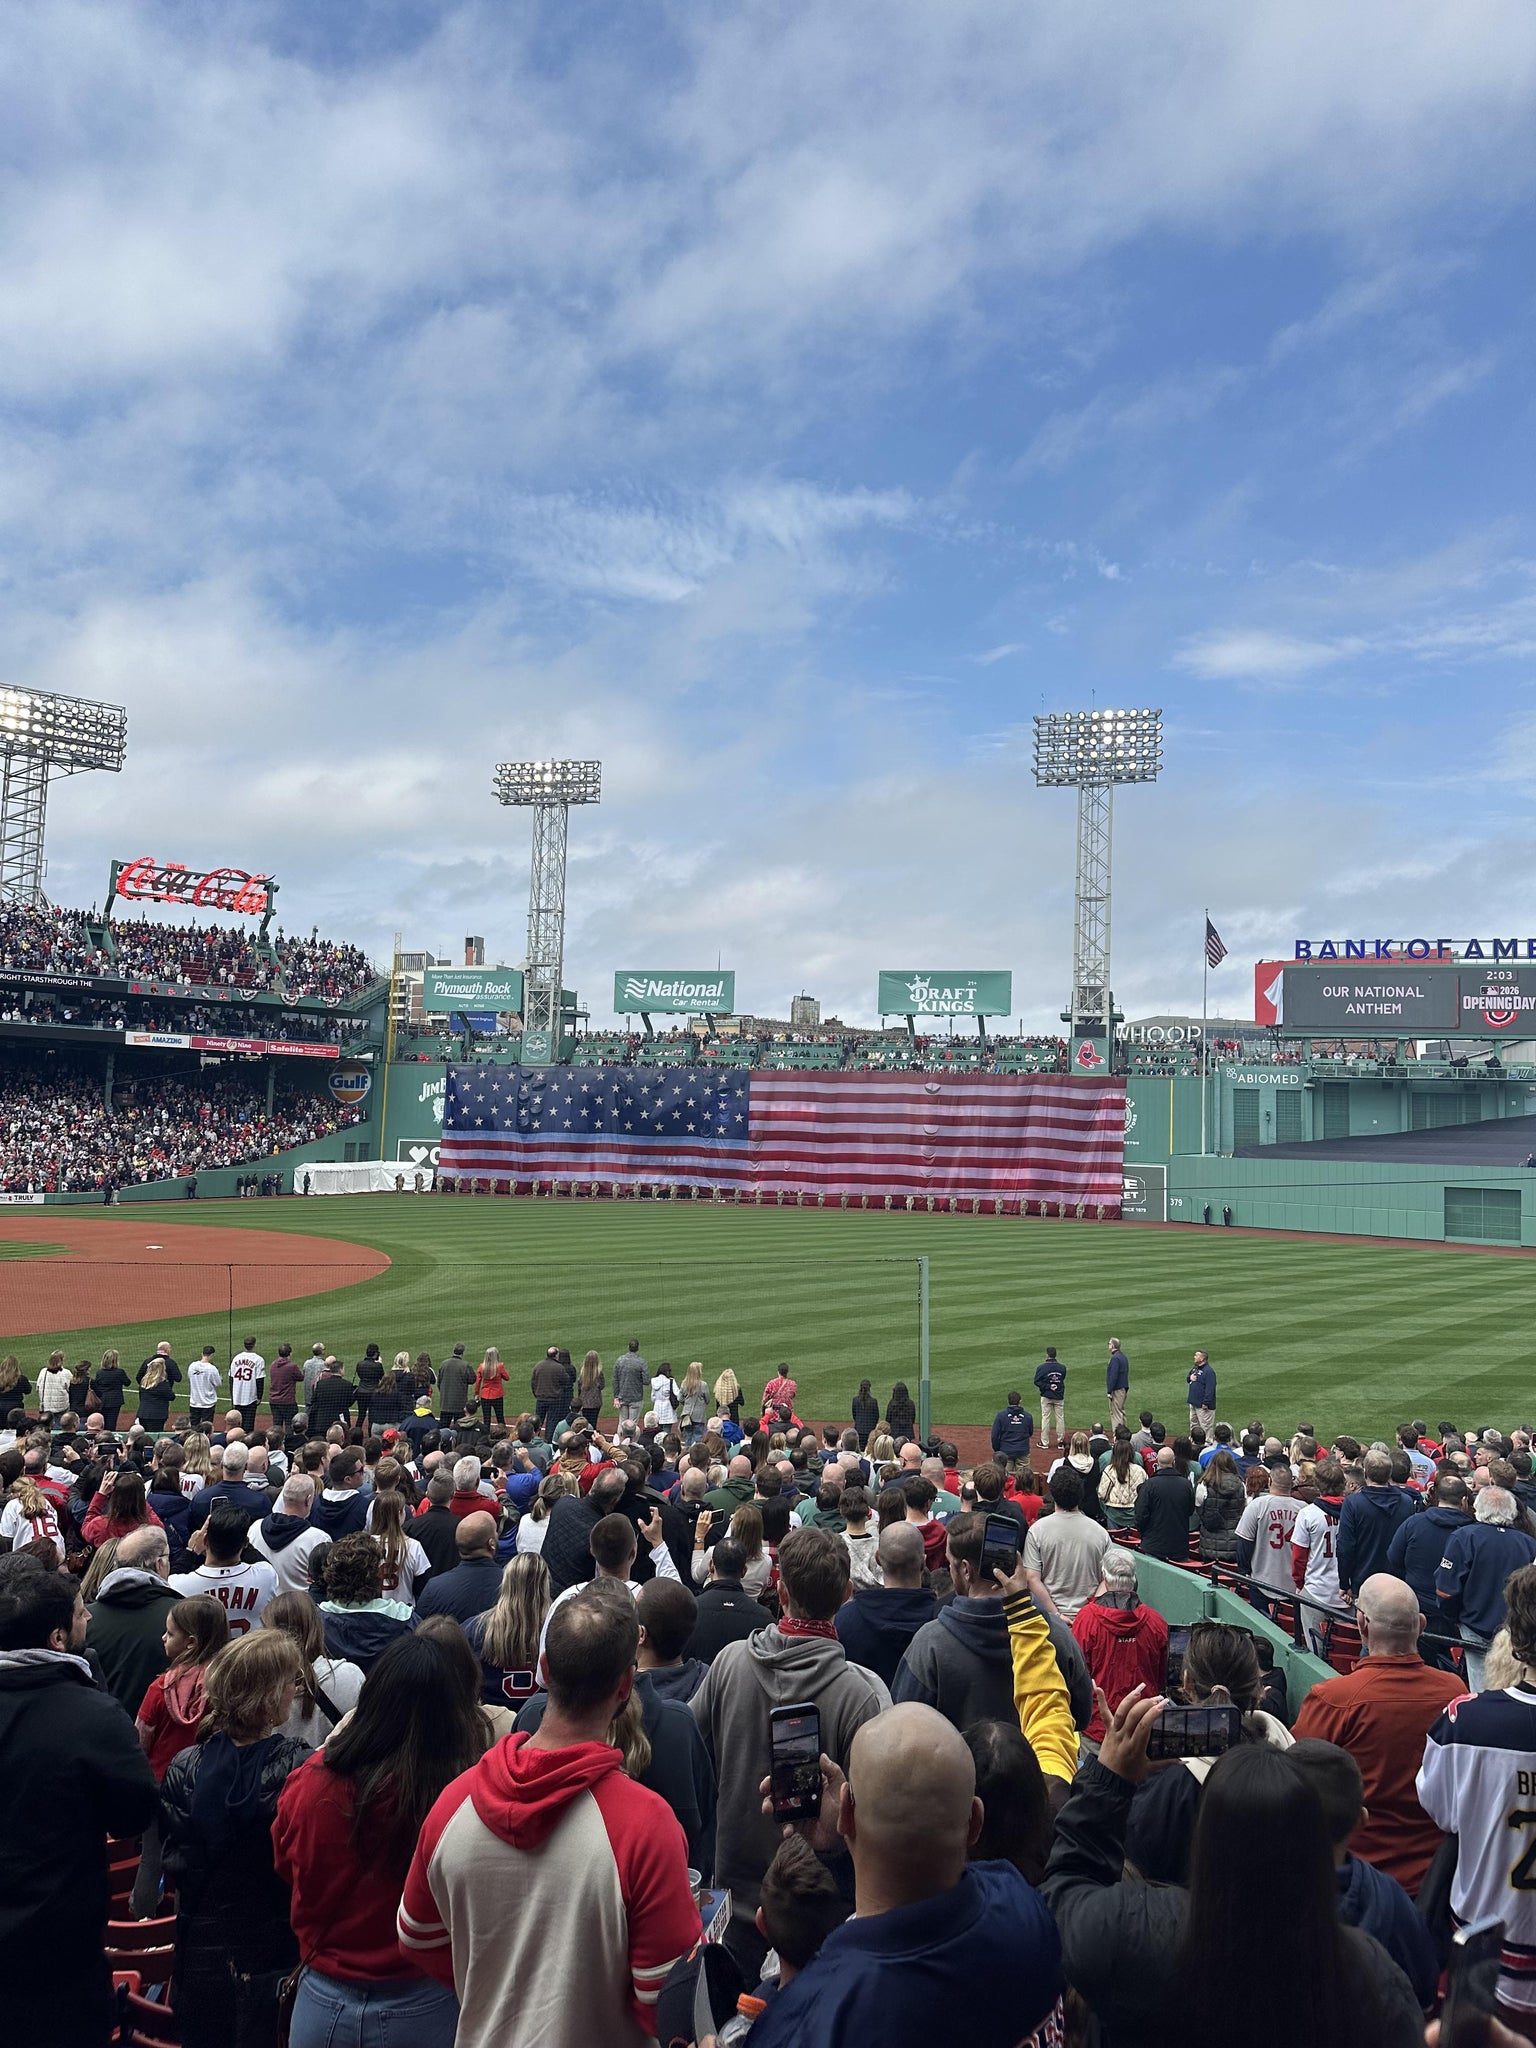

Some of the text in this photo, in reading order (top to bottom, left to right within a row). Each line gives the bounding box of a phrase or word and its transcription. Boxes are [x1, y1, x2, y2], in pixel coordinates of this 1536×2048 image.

[1295, 939, 1393, 960] BANK
[1407, 938, 1453, 960] OF
[0, 973, 93, 988] RIGHT STARSTHROUGH THE
[1487, 970, 1513, 980] 2:03
[434, 981, 511, 995] Plymouth Rock
[1323, 986, 1424, 998] OUR NATIONAL
[1500, 986, 1520, 995] 2026
[909, 987, 977, 1002] DRAFT
[672, 998, 719, 1006] Car Rental
[917, 1000, 975, 1012] KINGS
[1346, 1003, 1402, 1015] ANTHEM
[1116, 1026, 1201, 1043] WHOOP
[206, 1040, 226, 1048] Ninety
[270, 1044, 304, 1054] Safelite
[329, 1075, 368, 1088] Gulf
[1237, 1074, 1299, 1084] ABIOMED
[418, 1081, 440, 1102] JIM
[1121, 1178, 1138, 1190] E
[1170, 1198, 1183, 1206] 379
[234, 1367, 253, 1381] 43
[1270, 1509, 1298, 1522] ORTIZ
[29, 1514, 59, 1540] 16
